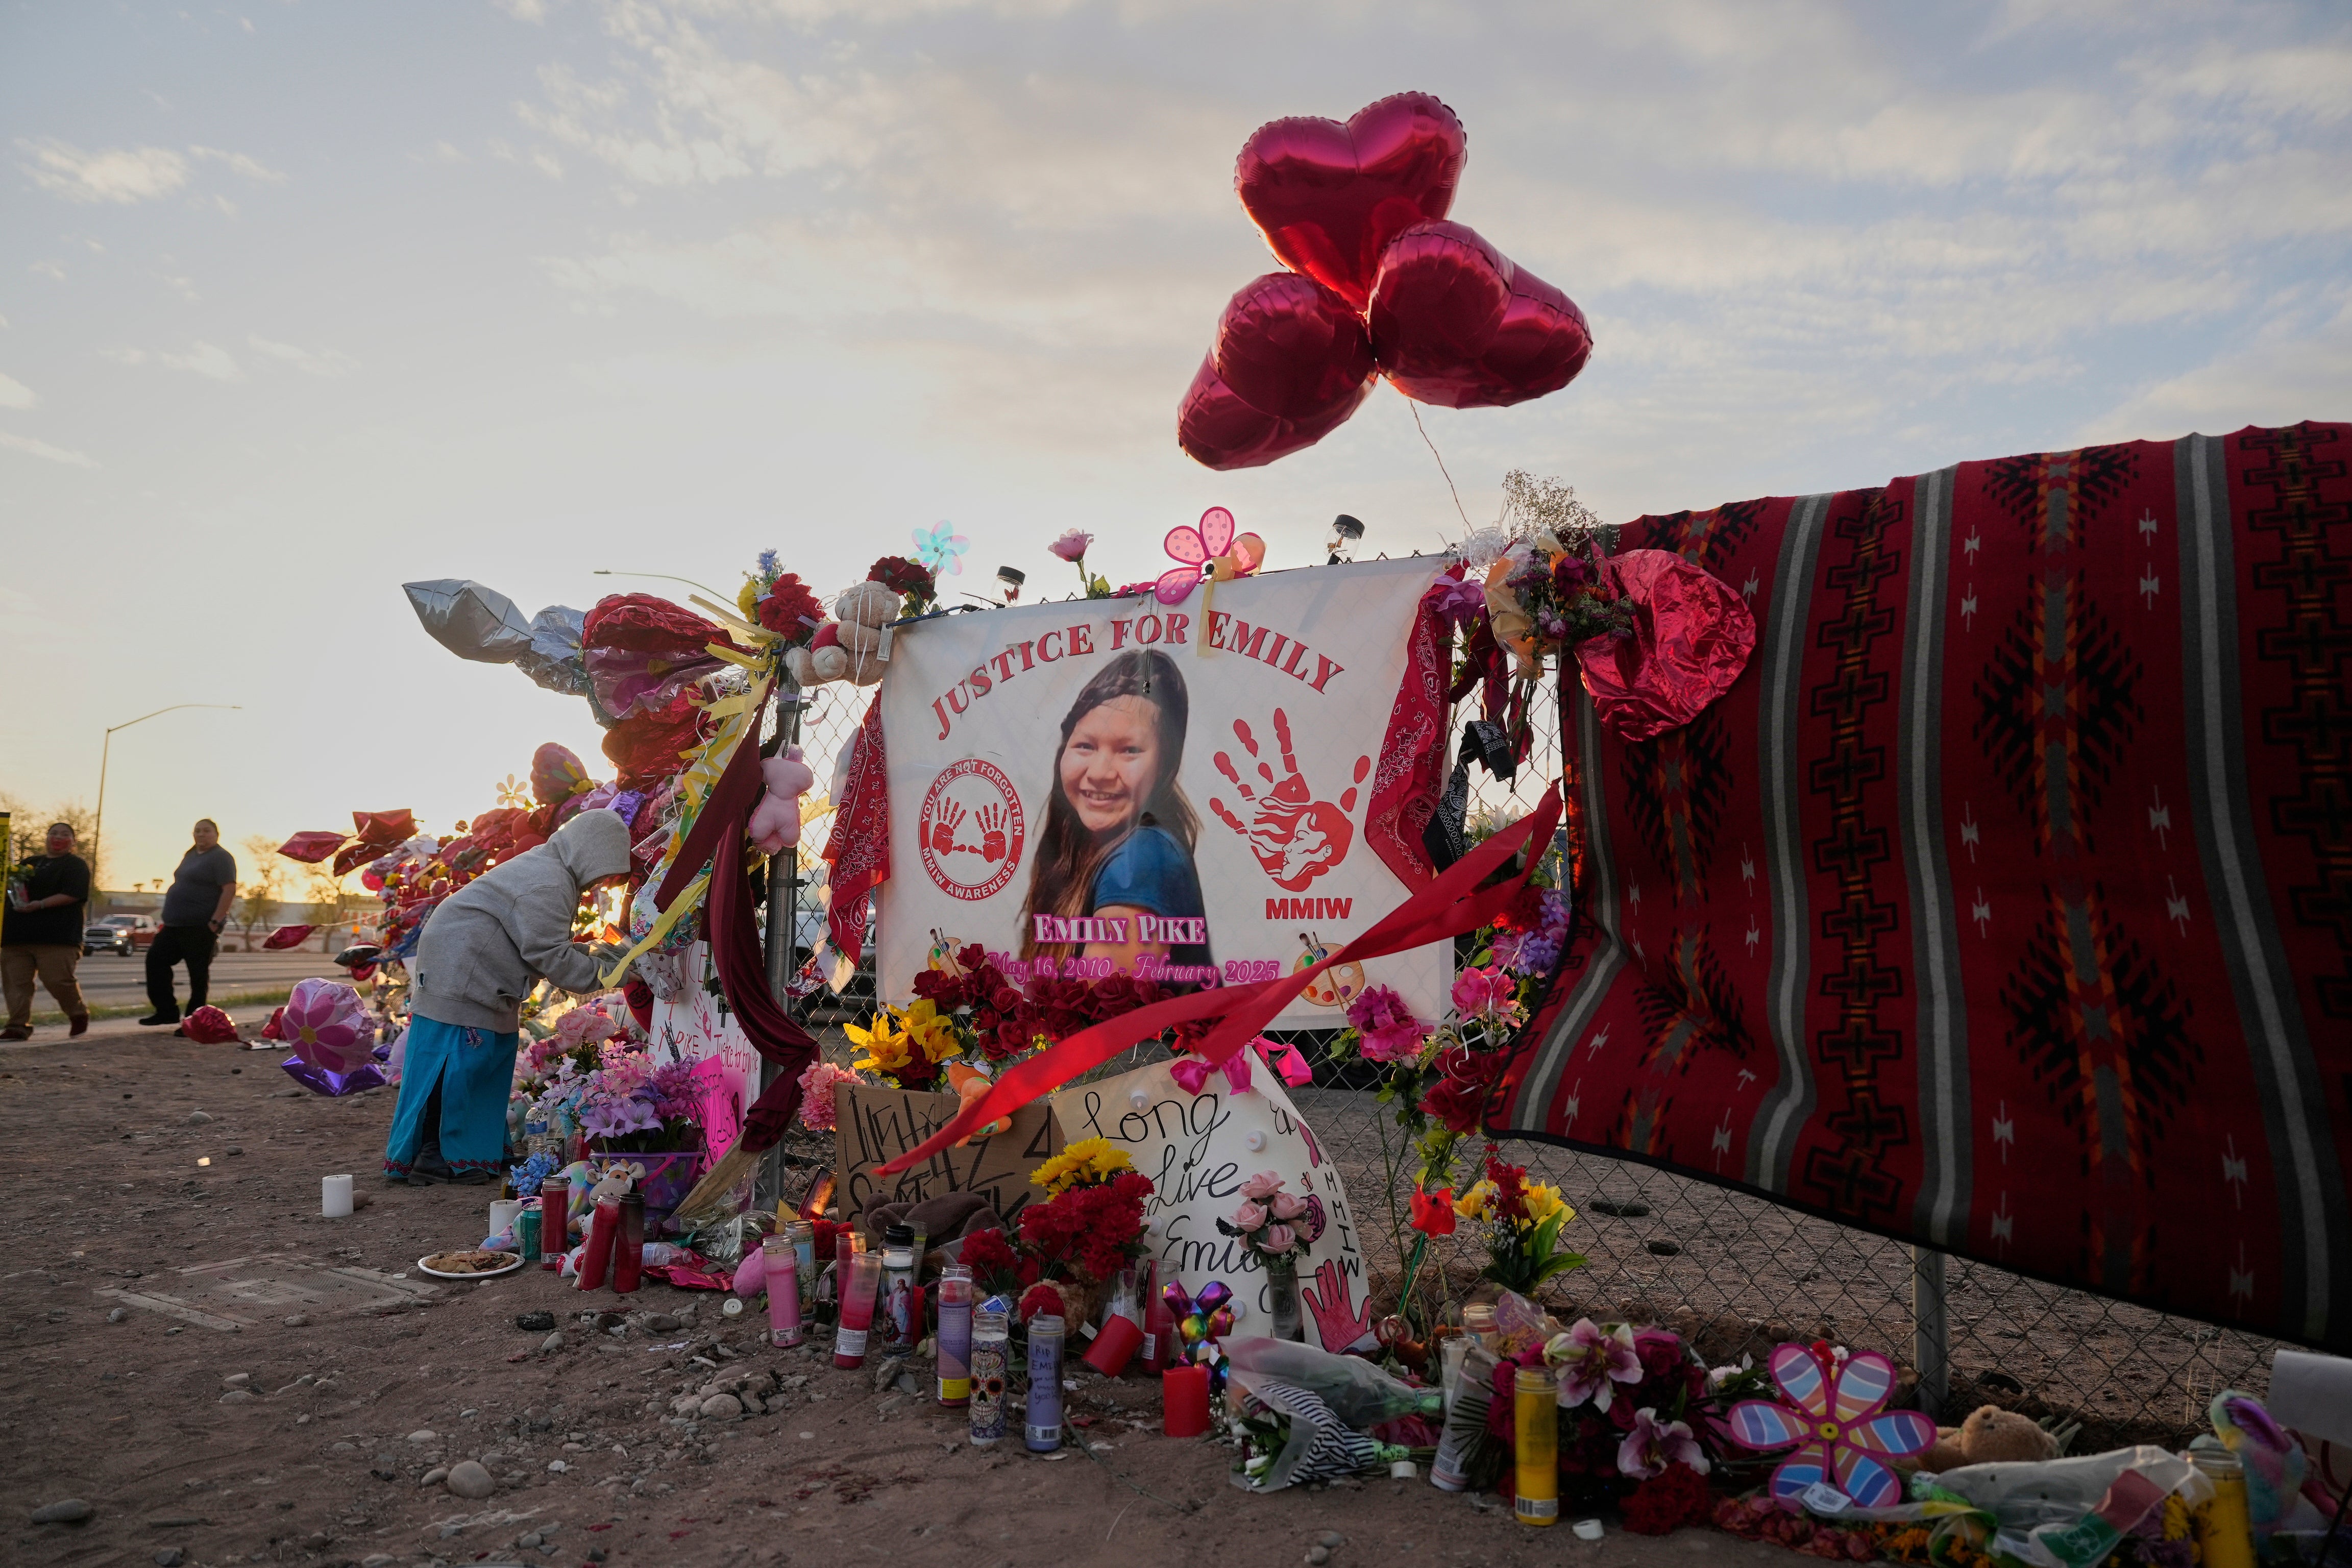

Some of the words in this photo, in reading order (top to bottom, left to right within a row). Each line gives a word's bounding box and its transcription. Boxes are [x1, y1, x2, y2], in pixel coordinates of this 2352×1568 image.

[932, 624, 1094, 741] JUSTICE
[1110, 613, 1190, 651] FOR
[1207, 610, 1344, 695] EMILY
[922, 793, 935, 823] YOU
[934, 769, 953, 792] ARE
[955, 761, 978, 775] NOT
[981, 763, 1022, 836] FORGOTTEN
[922, 846, 946, 886] MMIW
[946, 860, 1016, 899] AWARENESS
[1266, 898, 1353, 920] MMIW
[1034, 914, 1129, 943] EMILY
[1136, 914, 1206, 944] PIKE
[988, 952, 1027, 983] May
[1034, 957, 1059, 979] 16,
[1064, 958, 1111, 978] 2010
[1132, 952, 1219, 989] February
[1225, 960, 1280, 982] 2025
[1082, 1091, 1231, 1167] Long
[1147, 1144, 1251, 1217] Live
[1325, 1171, 1360, 1278] MMIW
